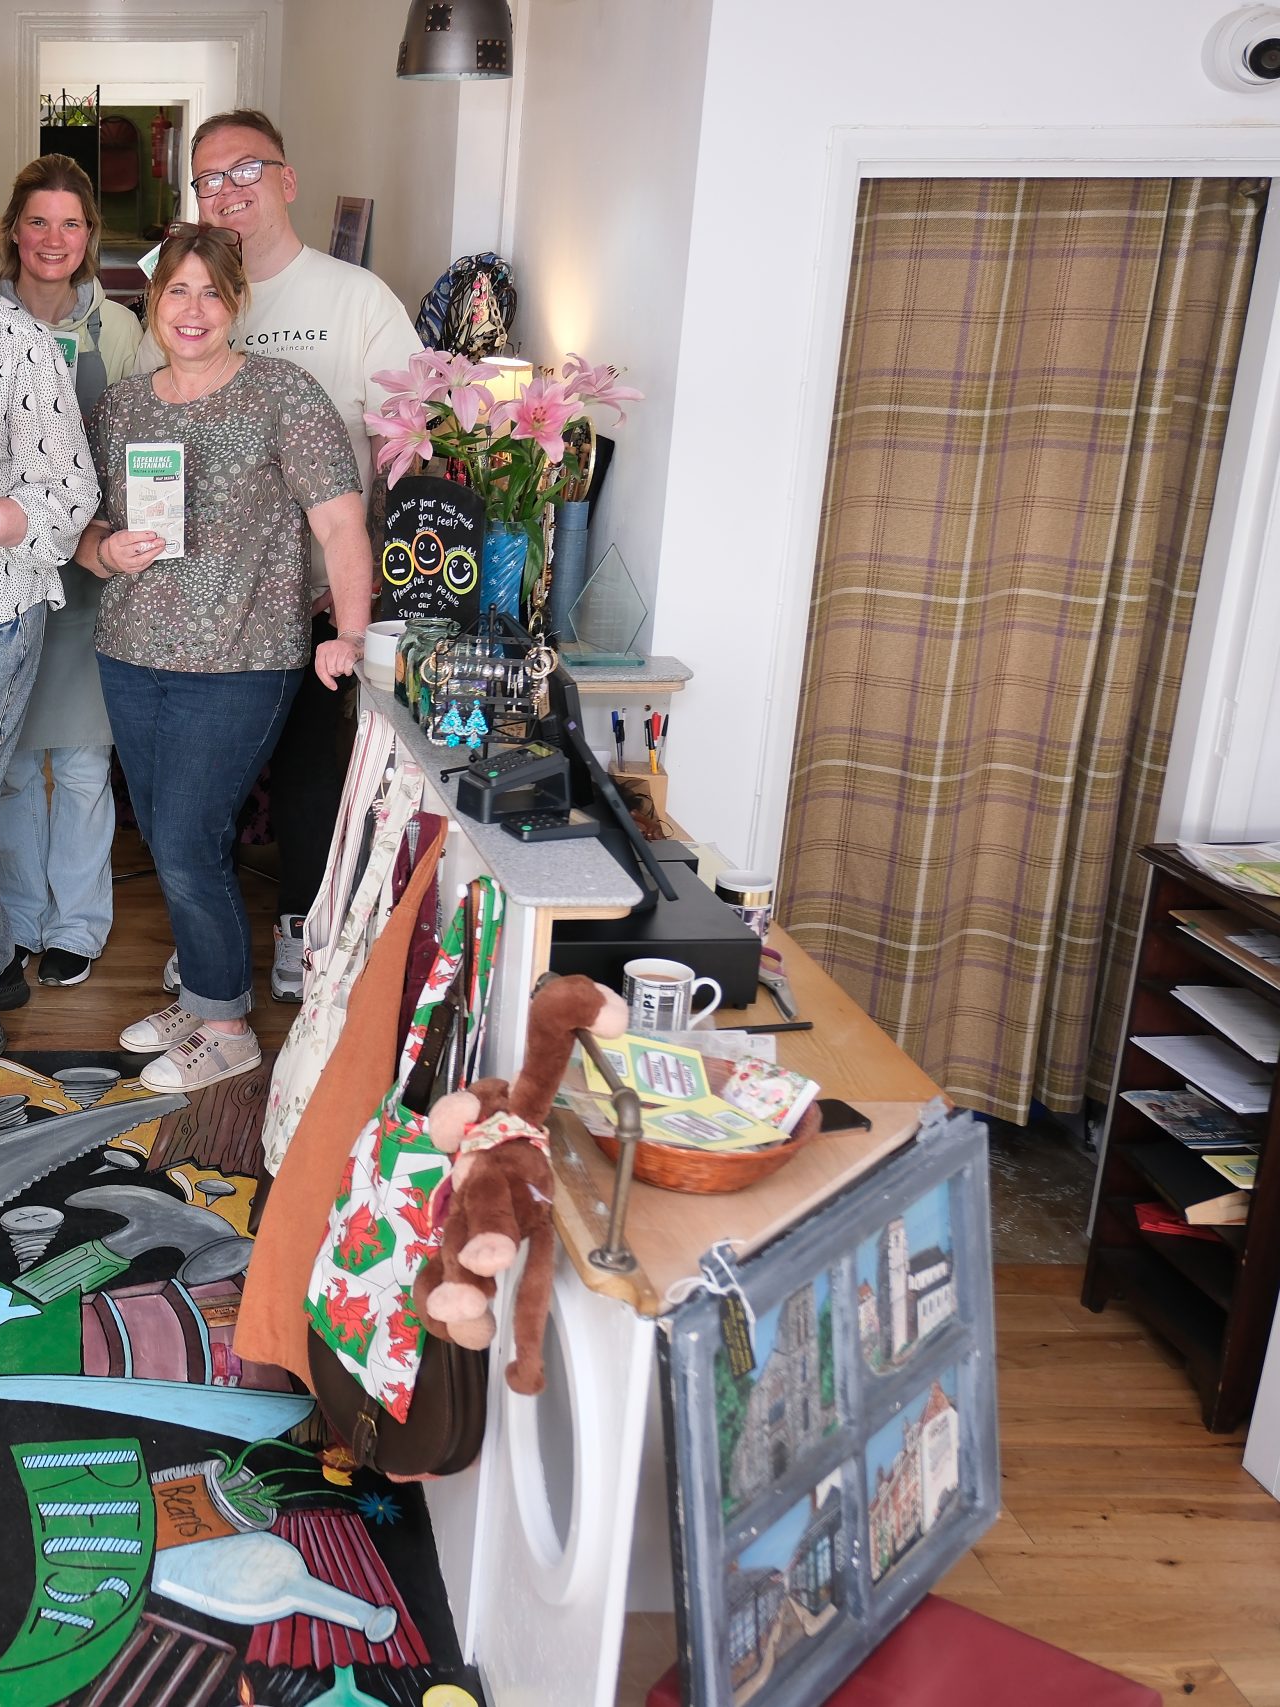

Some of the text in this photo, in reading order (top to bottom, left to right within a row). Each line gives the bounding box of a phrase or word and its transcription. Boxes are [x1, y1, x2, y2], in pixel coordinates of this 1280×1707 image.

[245, 330, 328, 346] COTTAGE
[132, 455, 171, 463] EXPERIENCE
[387, 499, 474, 531] How has your visit made
[418, 513, 433, 527] you
[392, 582, 413, 602] Please
[436, 585, 459, 607] pebble
[437, 600, 447, 611] of
[158, 1484, 212, 1537] Beans
[21, 1450, 143, 1642] REUSE
